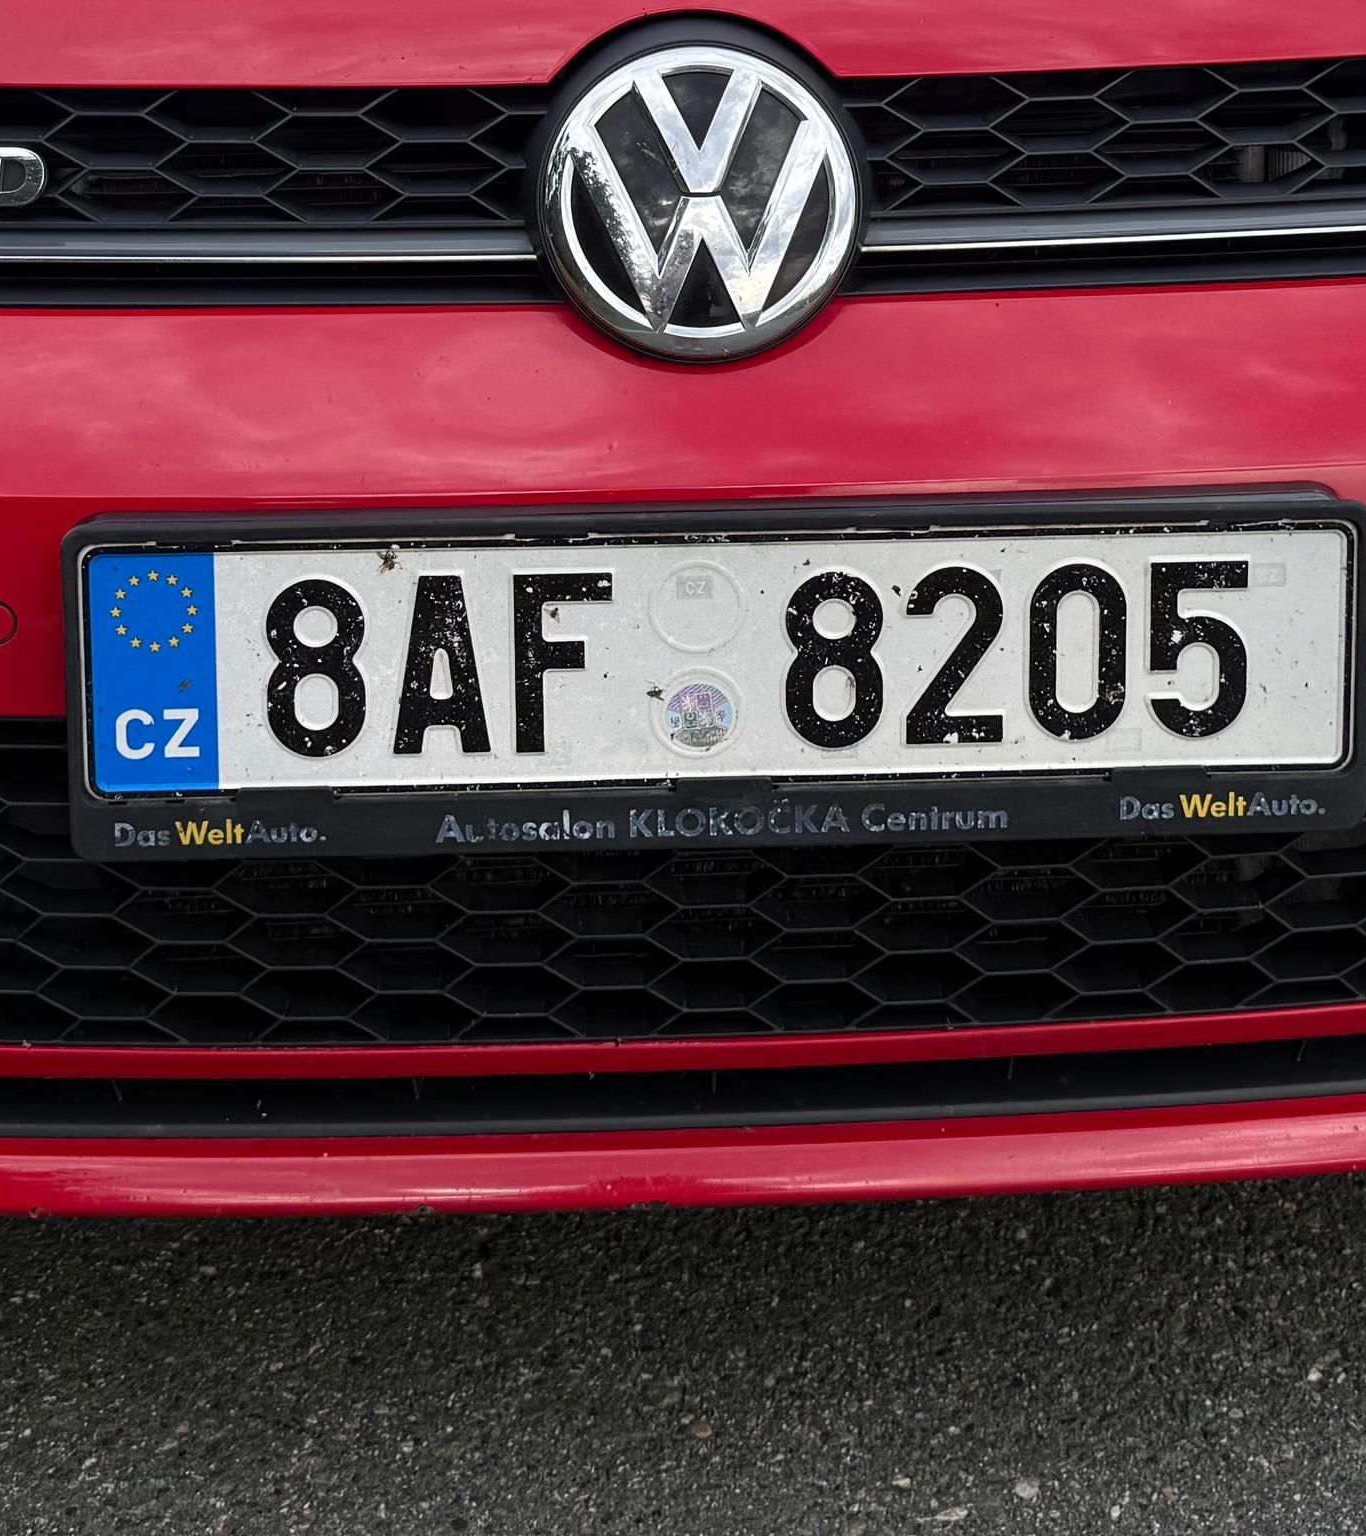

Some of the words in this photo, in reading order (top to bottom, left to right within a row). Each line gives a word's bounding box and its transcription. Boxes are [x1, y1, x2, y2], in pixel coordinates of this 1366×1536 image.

[686, 580, 707, 596] CZ
[266, 571, 613, 758] 8AF
[785, 560, 1250, 748] 8205
[115, 707, 201, 760] CZ
[435, 809, 616, 844] Autosalon
[629, 798, 851, 838] KLOKOČKA
[861, 802, 1009, 833] Centrum
[1119, 795, 1175, 821] Das
[114, 821, 172, 847] Das
